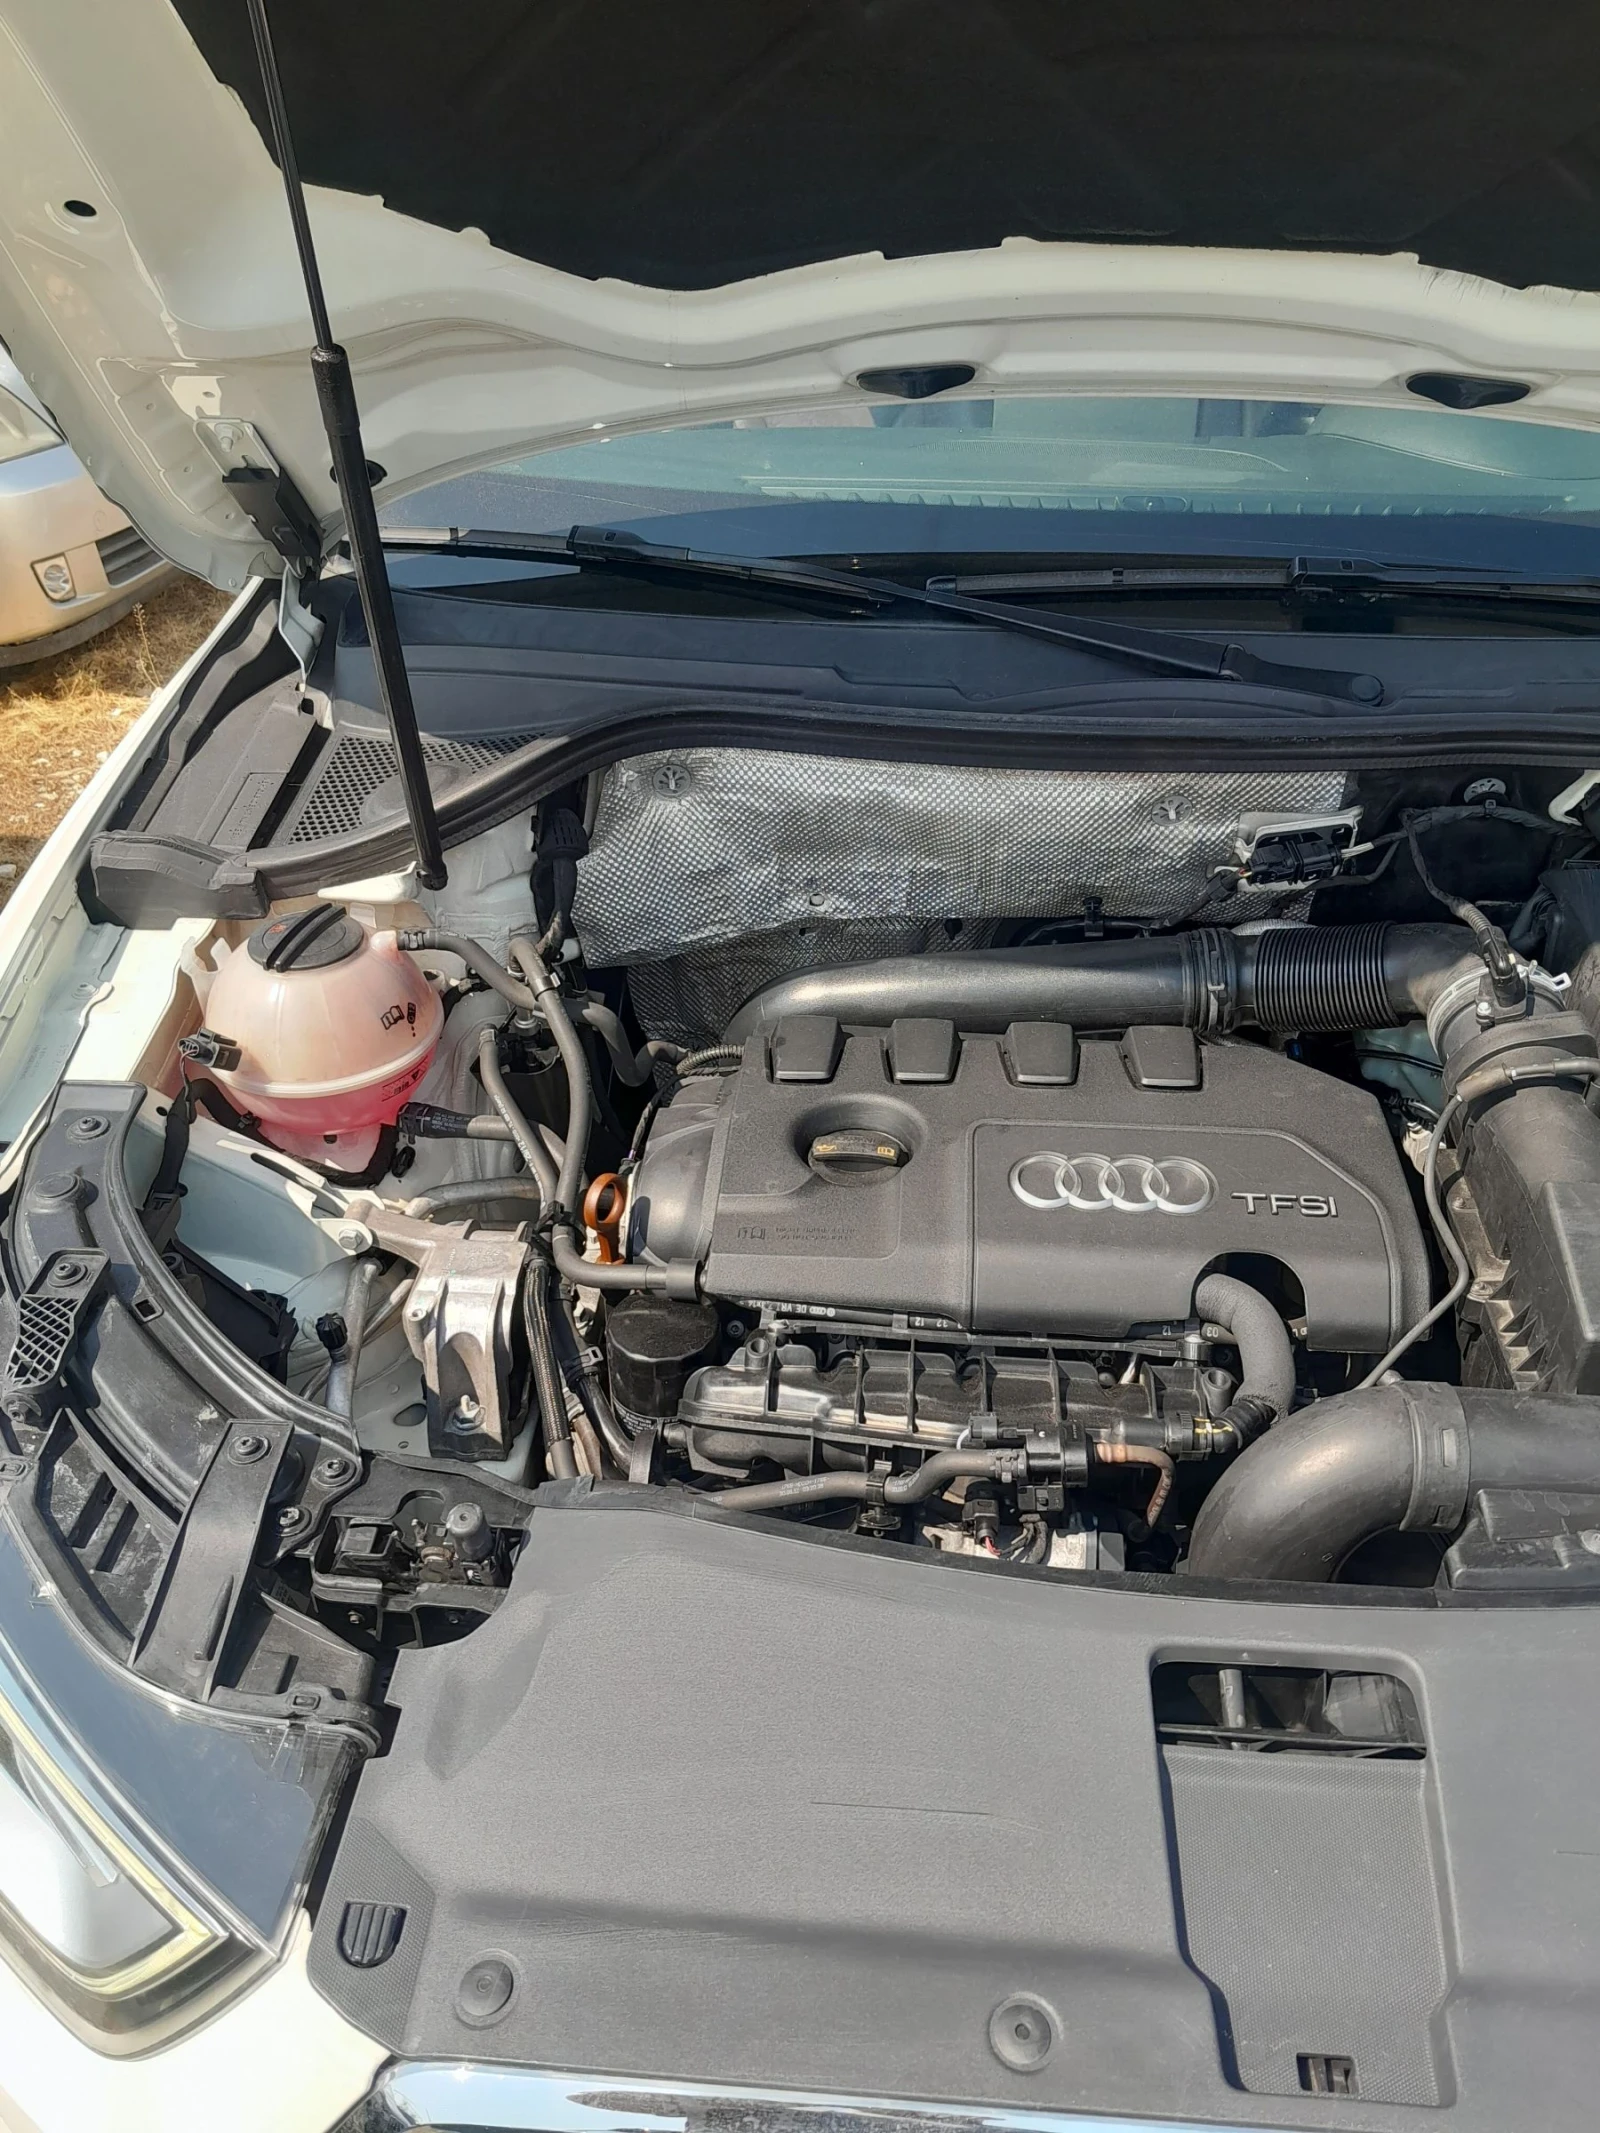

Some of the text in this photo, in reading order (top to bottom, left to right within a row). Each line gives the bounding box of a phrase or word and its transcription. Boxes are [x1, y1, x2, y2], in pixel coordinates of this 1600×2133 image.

[1230, 1192, 1338, 1217] TFSI
[914, 1317, 925, 1327] 12
[1162, 1325, 1172, 1336] 12
[1206, 1327, 1219, 1338] 03
